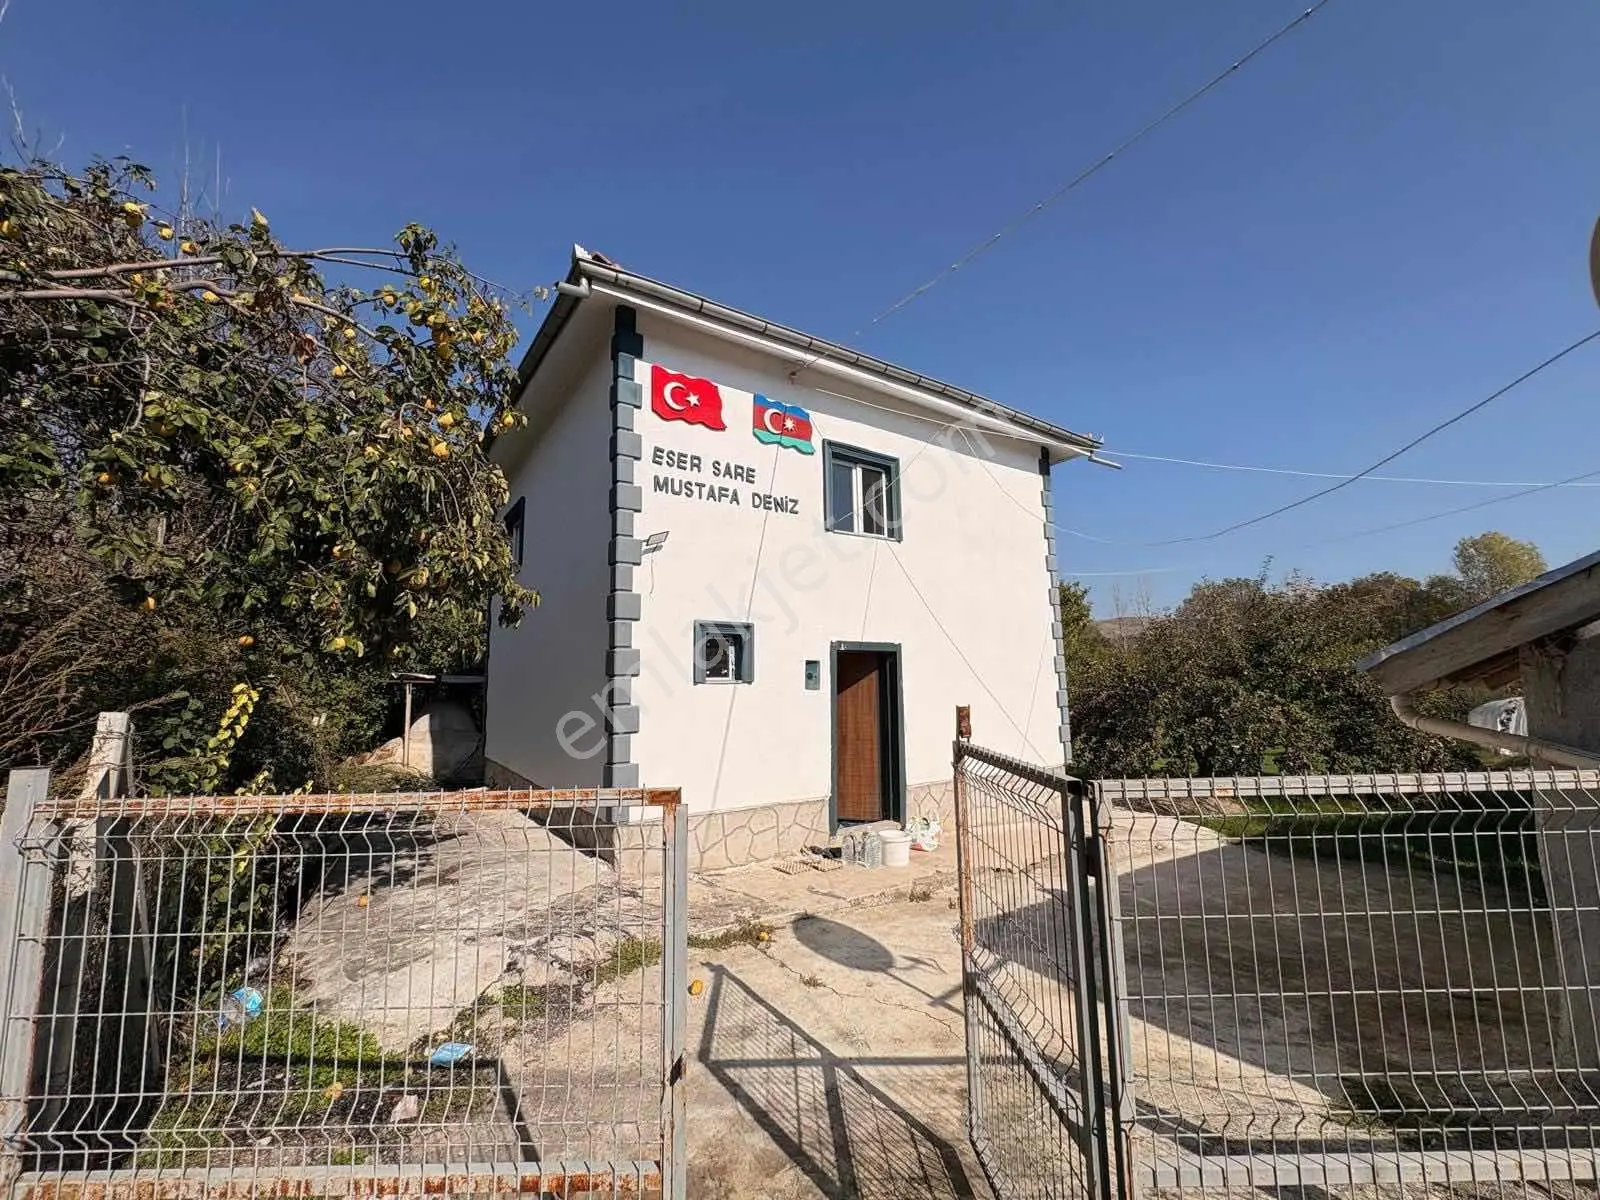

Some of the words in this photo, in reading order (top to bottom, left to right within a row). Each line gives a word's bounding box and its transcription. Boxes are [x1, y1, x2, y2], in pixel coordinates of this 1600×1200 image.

[652, 446, 702, 473] ESER
[712, 460, 756, 484] SARE
[653, 475, 740, 506] MUSTAFA
